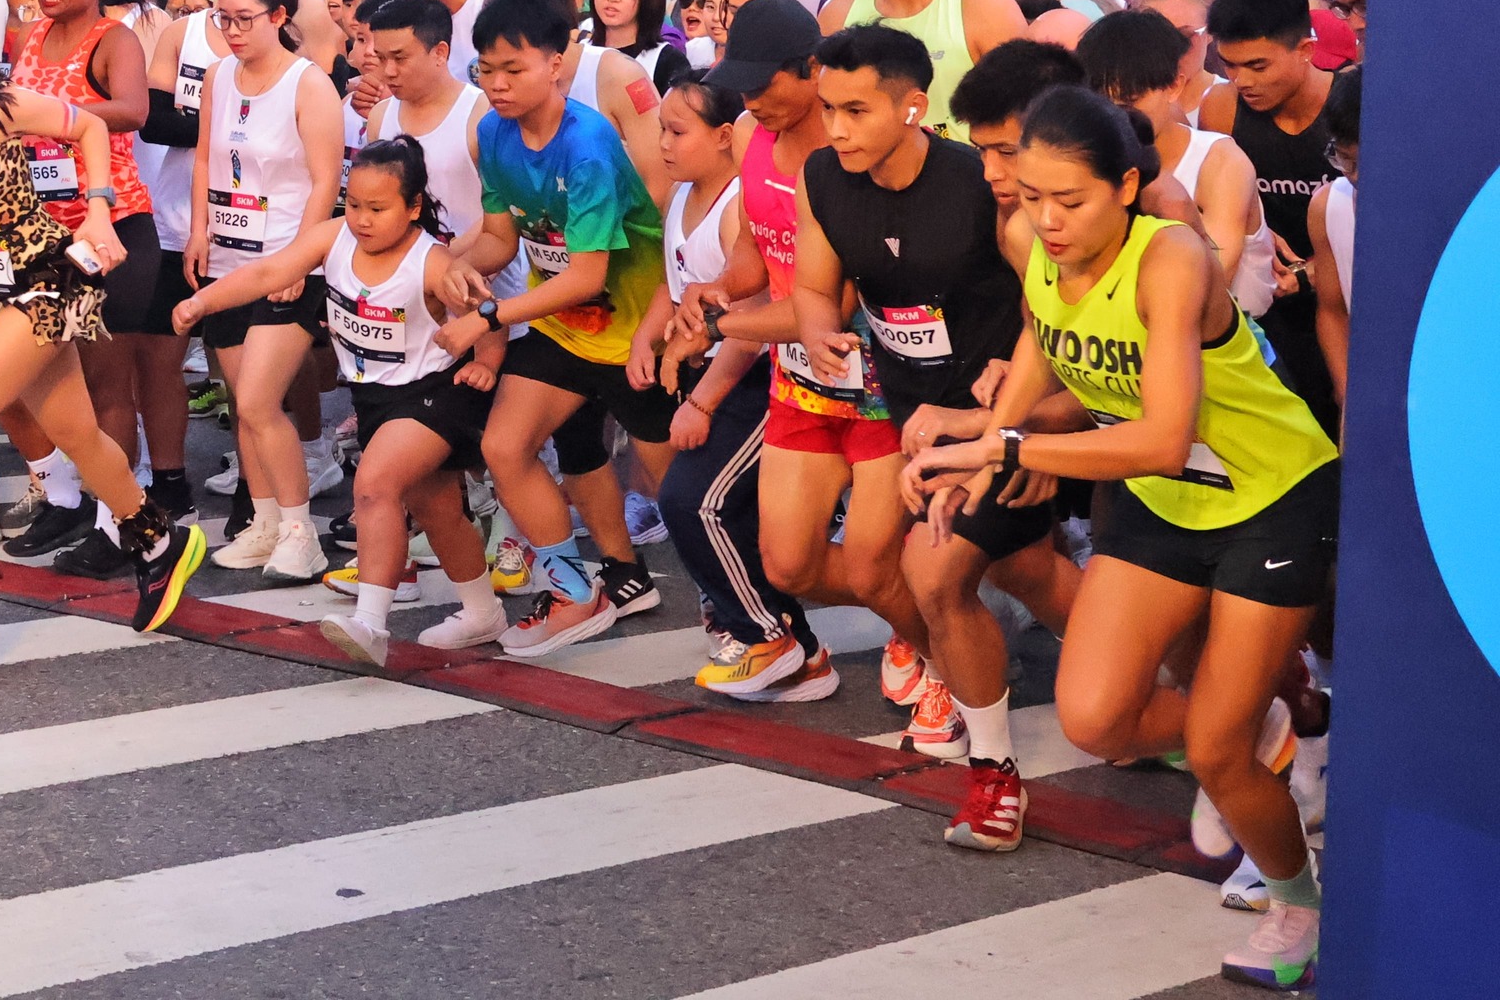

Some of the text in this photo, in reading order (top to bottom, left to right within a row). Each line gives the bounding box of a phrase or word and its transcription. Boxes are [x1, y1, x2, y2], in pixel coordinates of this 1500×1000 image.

[41, 148, 59, 157] 5KM
[236, 196, 254, 207] 5KM
[215, 210, 249, 228] 51226
[529, 244, 543, 259] M
[364, 307, 386, 319] 5KM
[891, 311, 920, 321] 5KM
[334, 308, 393, 341] F 50975
[875, 321, 936, 345] 50057
